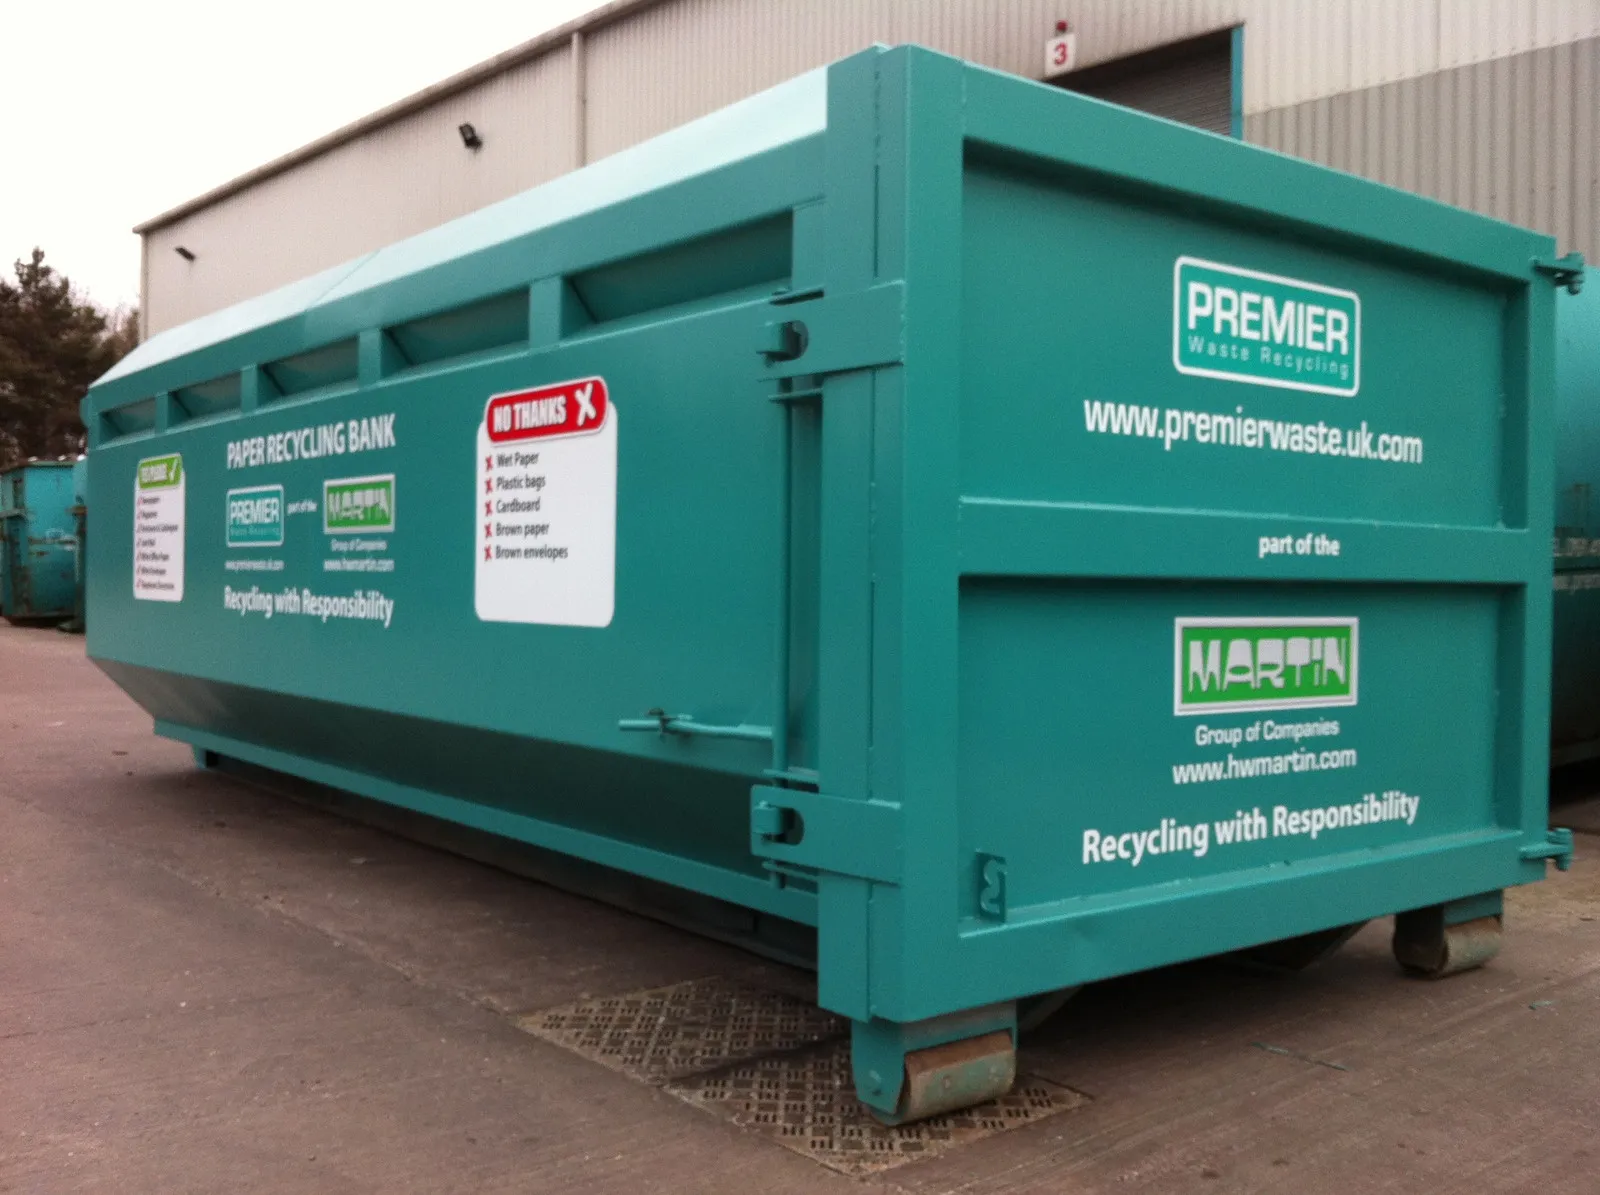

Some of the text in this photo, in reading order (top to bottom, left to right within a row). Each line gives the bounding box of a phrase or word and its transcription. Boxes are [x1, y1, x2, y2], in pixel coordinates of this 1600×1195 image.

[1054, 43, 1068, 66] 3
[1188, 281, 1349, 355] PREMIER
[1188, 336, 1350, 380] Waste Recycling
[493, 394, 567, 433] NO THANKS
[227, 413, 396, 469] PAPER RECYCLING BANK
[1084, 400, 1423, 464] www.premierwaste.uk.com
[514, 452, 540, 468] Paper
[496, 474, 546, 492] Plastic bags
[229, 497, 280, 525] PREMIER
[328, 488, 391, 521] MARTIN
[496, 496, 541, 513] Cardboard
[496, 522, 549, 540] Brown paper
[1259, 533, 1340, 557] part of the
[495, 544, 568, 563] Brown envelopes
[224, 585, 394, 629] Recycling with Responsibility
[1189, 637, 1346, 693] MARTIN
[1195, 718, 1340, 748] Group of Companies
[1173, 748, 1357, 784] www.hwmartin.com
[1082, 791, 1420, 867] Recycling with Responsibility
